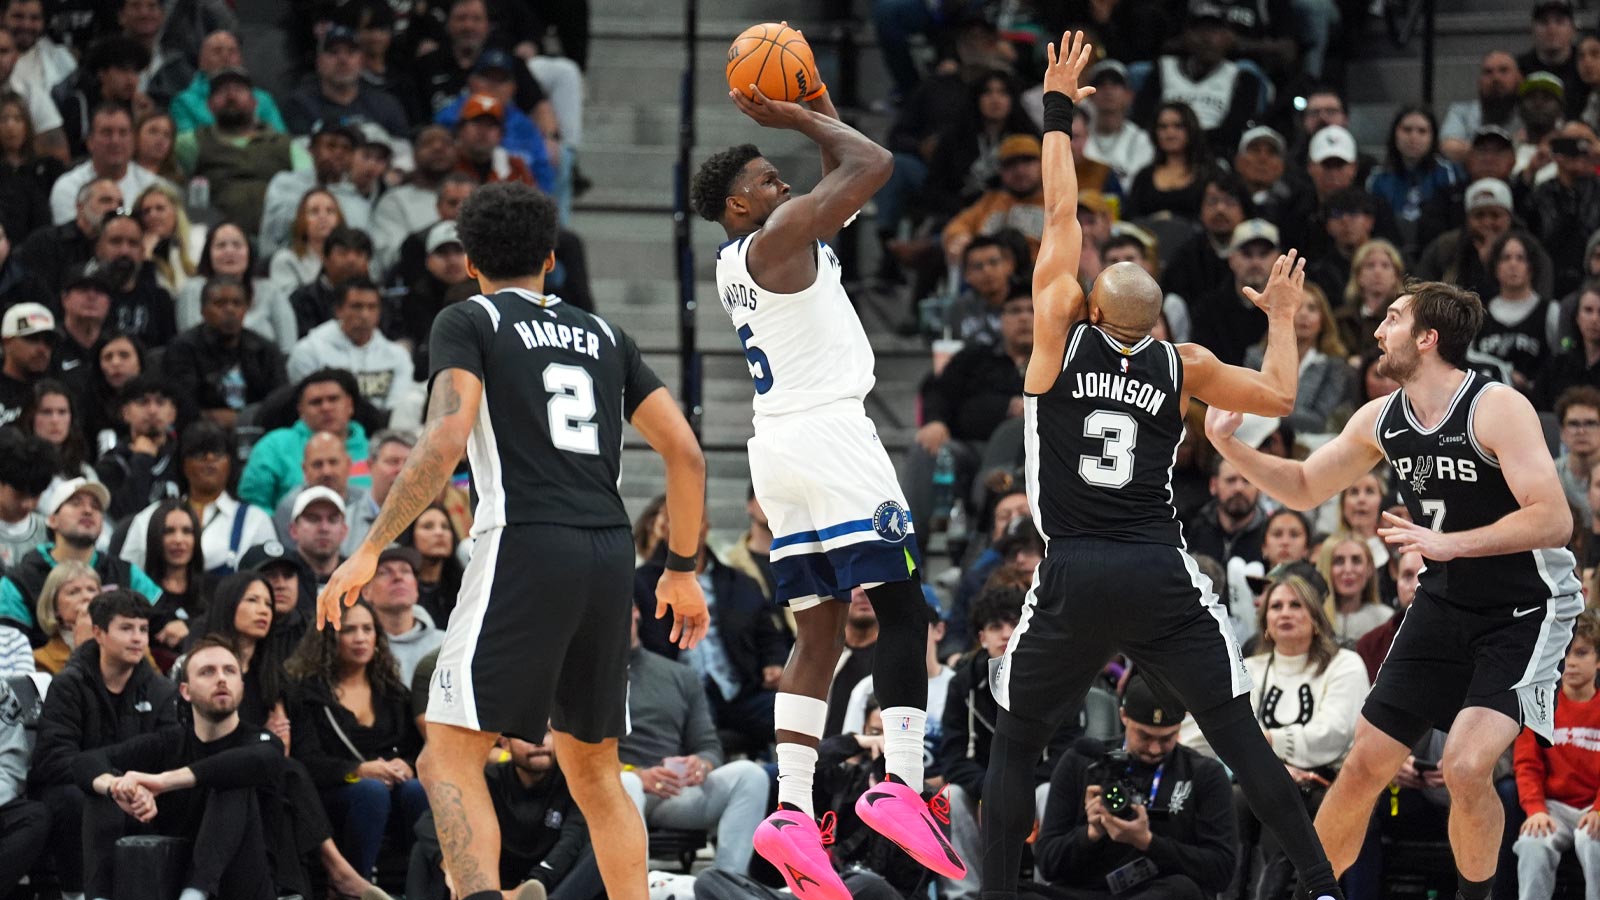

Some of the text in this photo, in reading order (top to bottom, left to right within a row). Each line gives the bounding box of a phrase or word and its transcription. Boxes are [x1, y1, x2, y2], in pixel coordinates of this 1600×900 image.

[513, 320, 599, 360] HARPER
[737, 322, 774, 395] 5
[542, 362, 600, 455] 2
[1072, 372, 1167, 416] JOHNSON
[1078, 409, 1139, 489] 3
[1442, 435, 1464, 443] LEDGER
[1419, 499, 1447, 533] 7
